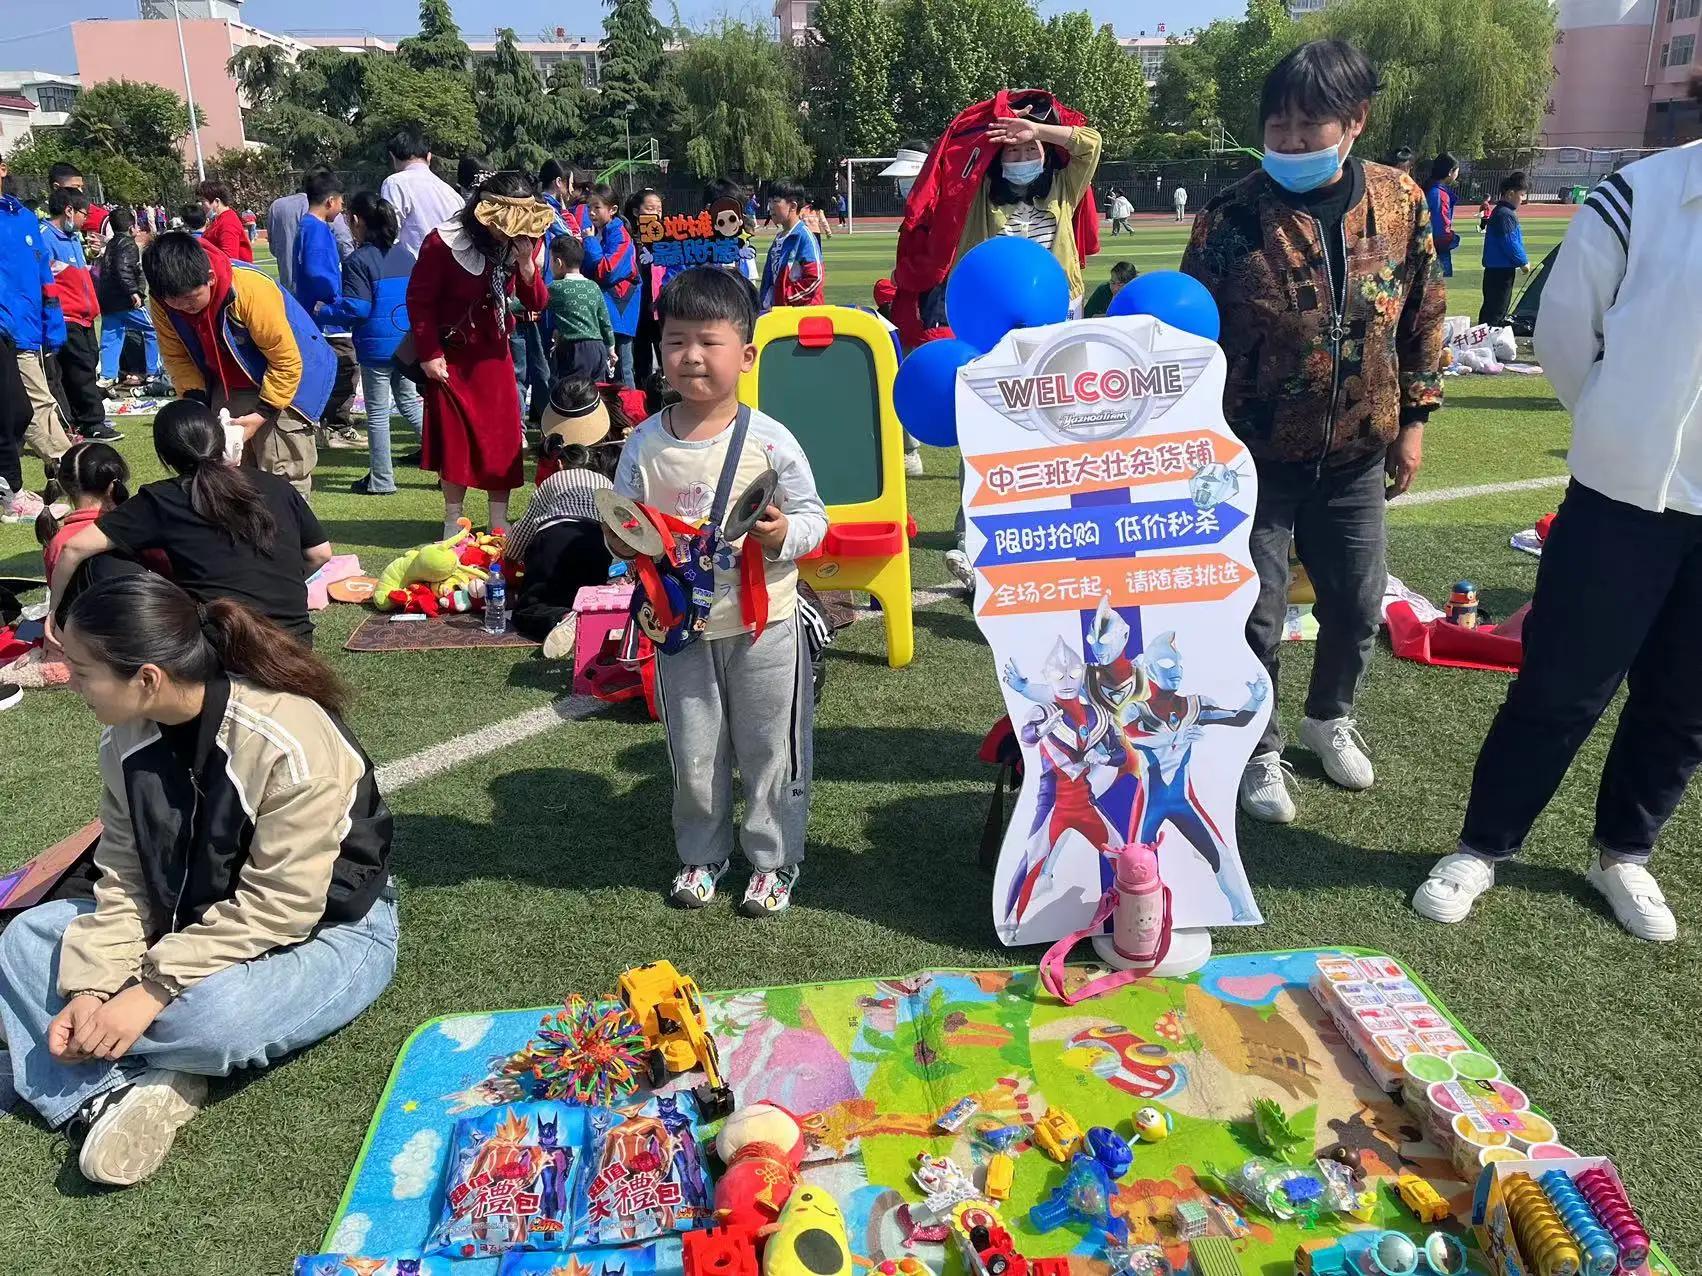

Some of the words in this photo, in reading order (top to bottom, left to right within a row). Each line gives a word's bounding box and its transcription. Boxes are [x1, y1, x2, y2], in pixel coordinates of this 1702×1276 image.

[997, 363, 1184, 410] WELCOME
[988, 439, 1214, 494] 中三班大壮杂货铺
[994, 520, 1100, 556] 限时抢购
[1114, 507, 1221, 545] 低价秒杀
[1125, 561, 1241, 594] 请随意挑选
